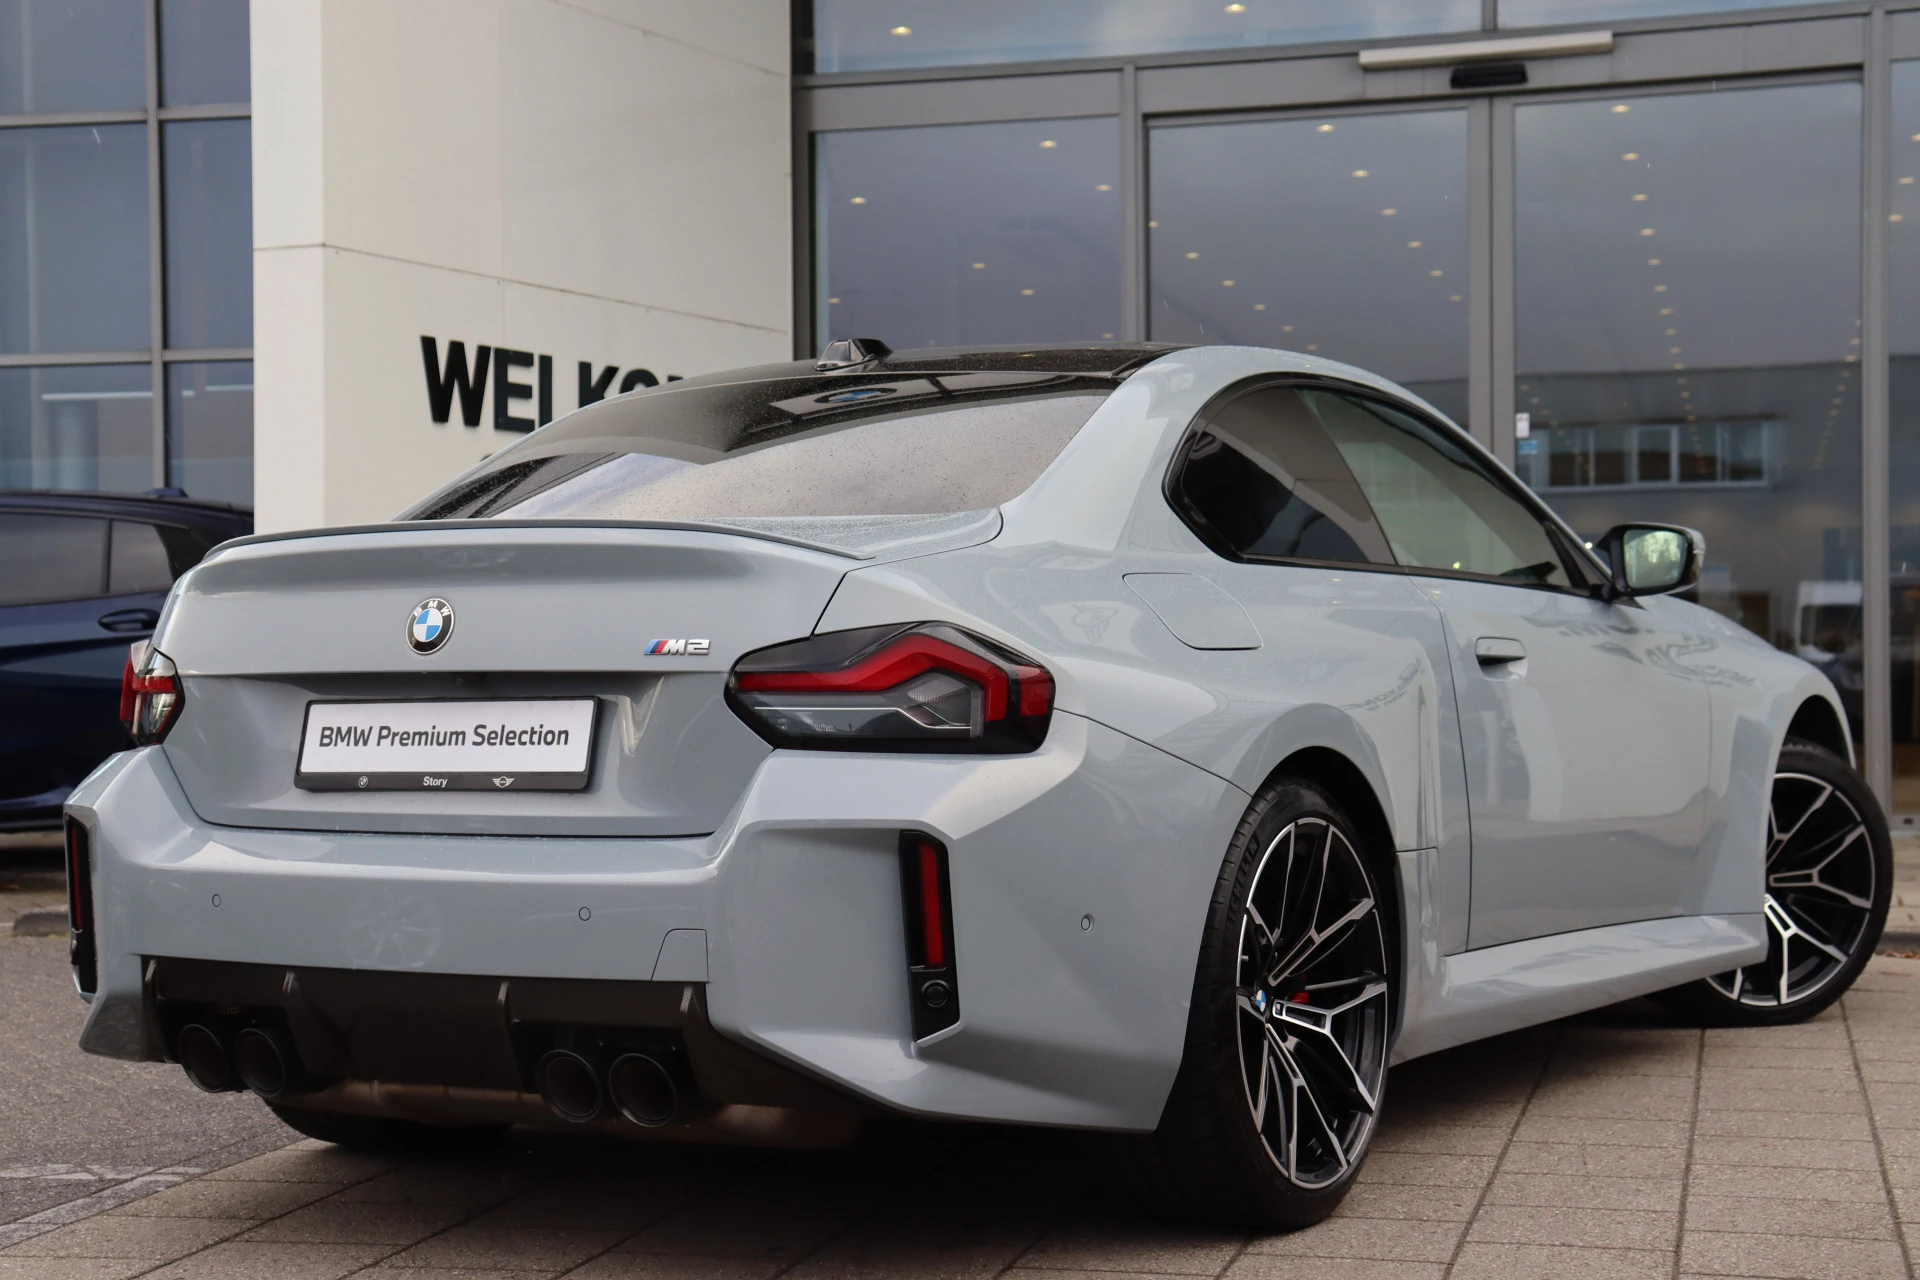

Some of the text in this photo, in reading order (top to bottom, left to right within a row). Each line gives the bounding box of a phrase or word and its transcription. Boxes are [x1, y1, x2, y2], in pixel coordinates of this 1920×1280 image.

[420, 335, 683, 433] WELK
[659, 638, 710, 655] M2
[319, 724, 569, 747] BMW Premium Selection
[423, 776, 448, 788] Story
